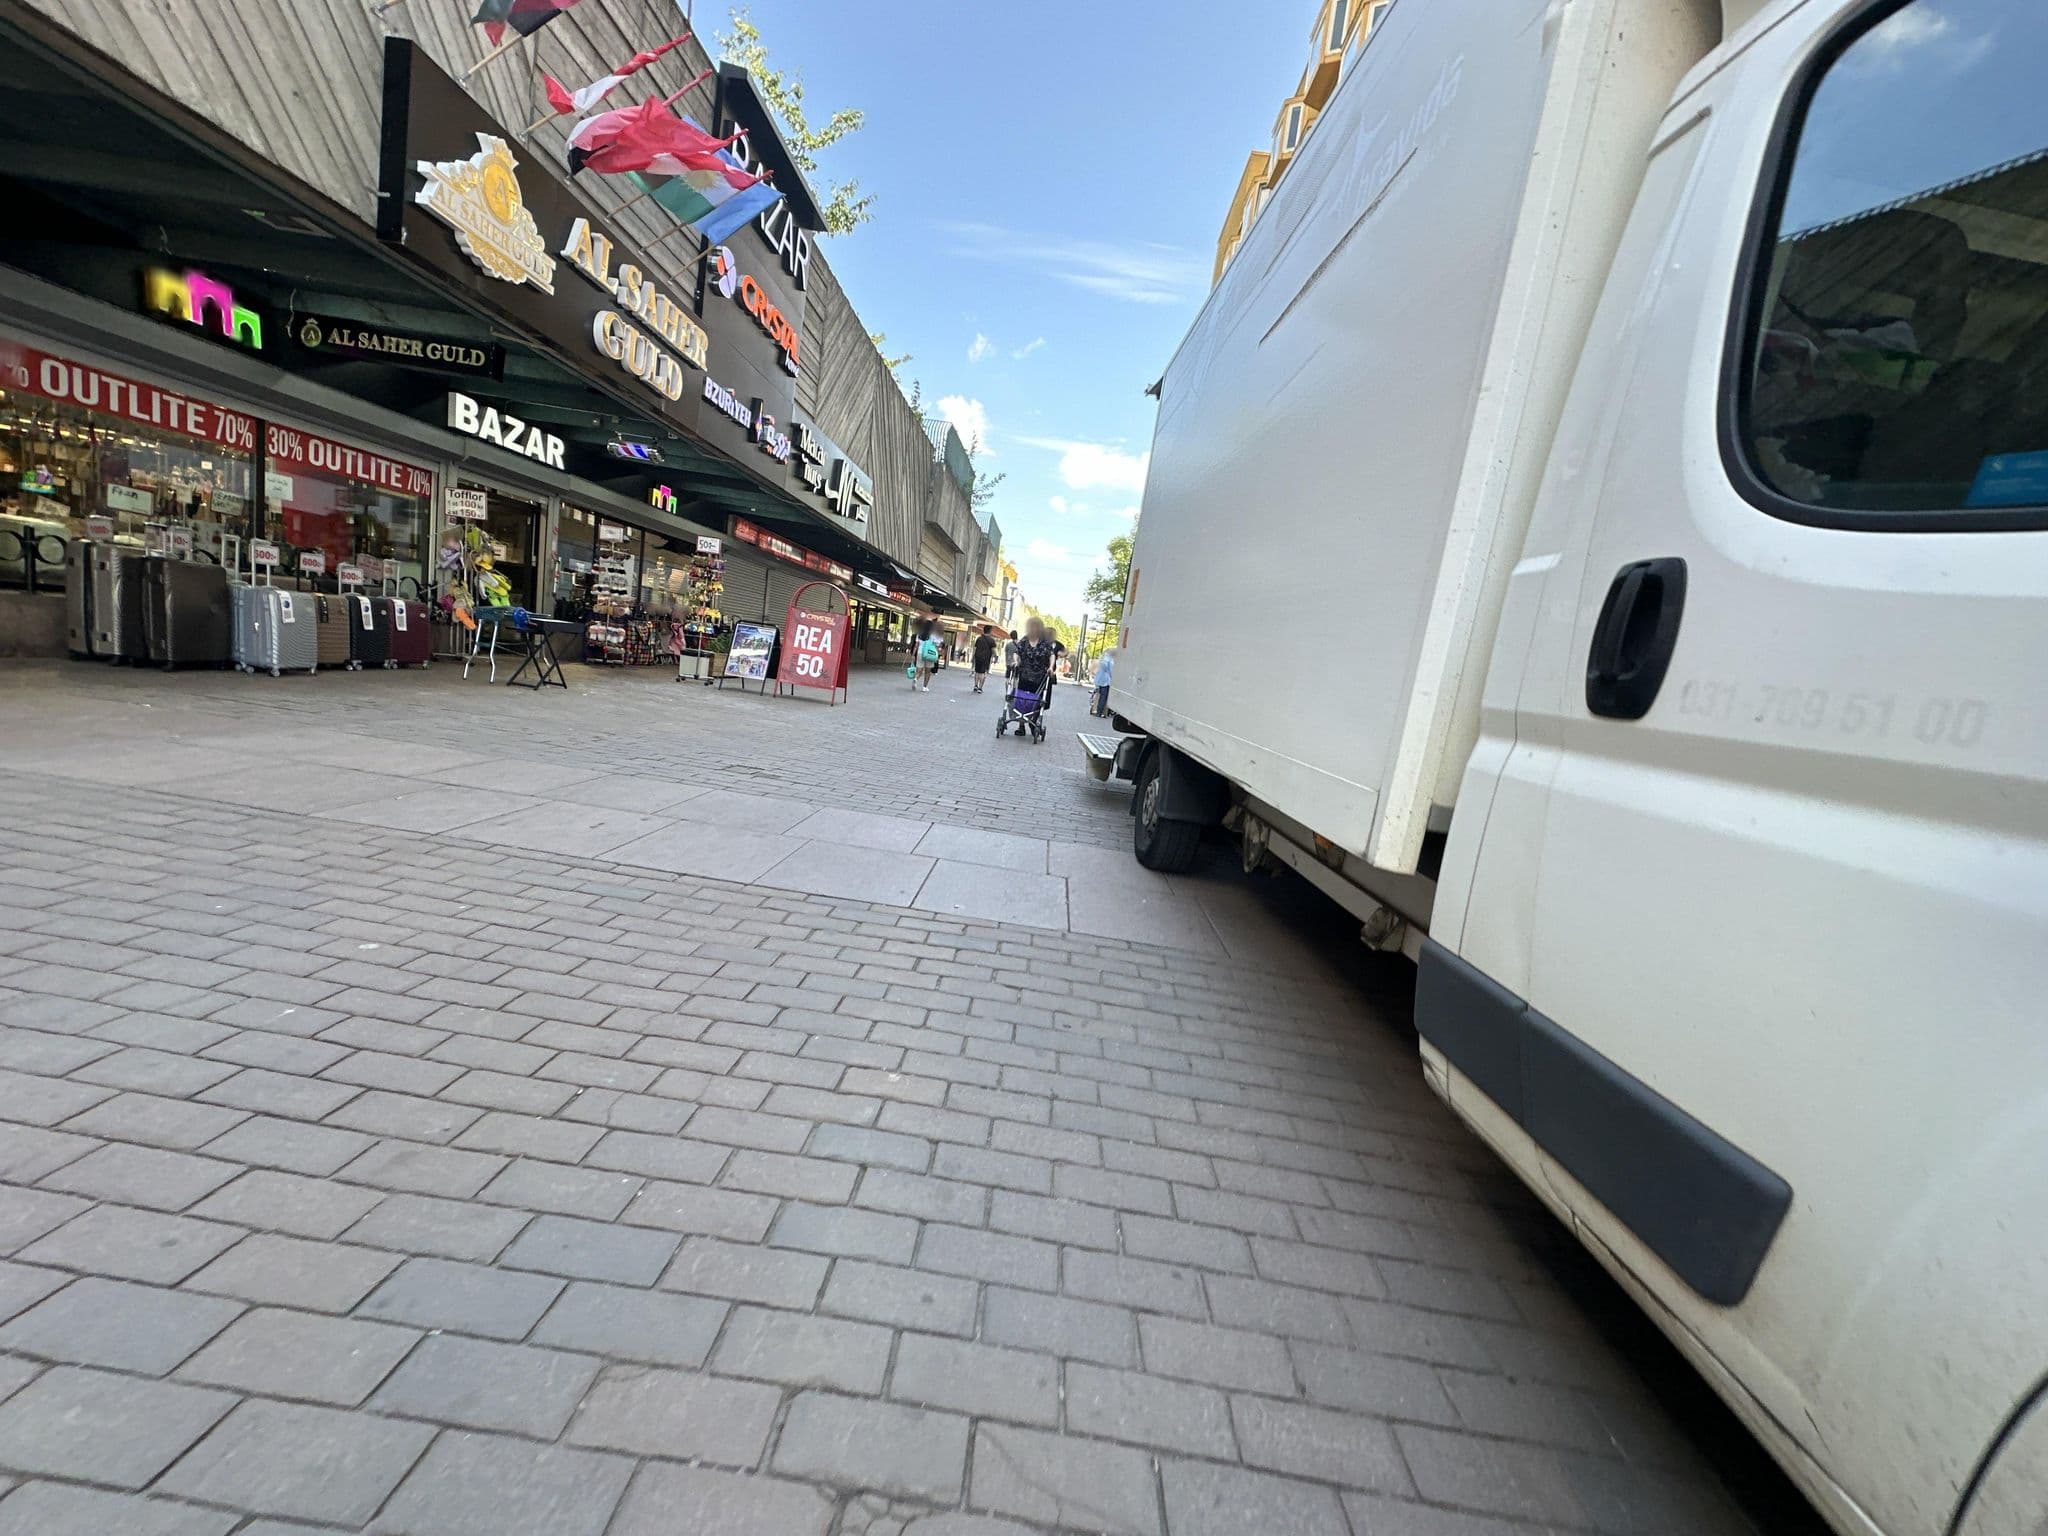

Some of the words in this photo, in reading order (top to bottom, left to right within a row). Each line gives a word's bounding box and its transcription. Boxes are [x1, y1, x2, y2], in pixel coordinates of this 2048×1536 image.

[560, 217, 619, 295] AL
[617, 263, 708, 372] SAHER
[328, 327, 354, 347] AL
[358, 331, 424, 358] SAHER
[426, 342, 486, 367] GULD
[593, 310, 683, 401] GULD
[40, 359, 207, 436] OUTLITE
[214, 410, 253, 449] 70%
[447, 391, 565, 470] BAZAR
[268, 426, 303, 462] 30%
[308, 439, 402, 488] OUTLITE
[407, 468, 431, 496] 70%
[448, 489, 483, 501] Tofflor
[460, 500, 477, 508] 100
[460, 509, 477, 518] 150
[793, 624, 832, 654] REA
[1911, 698, 1988, 748] 00
